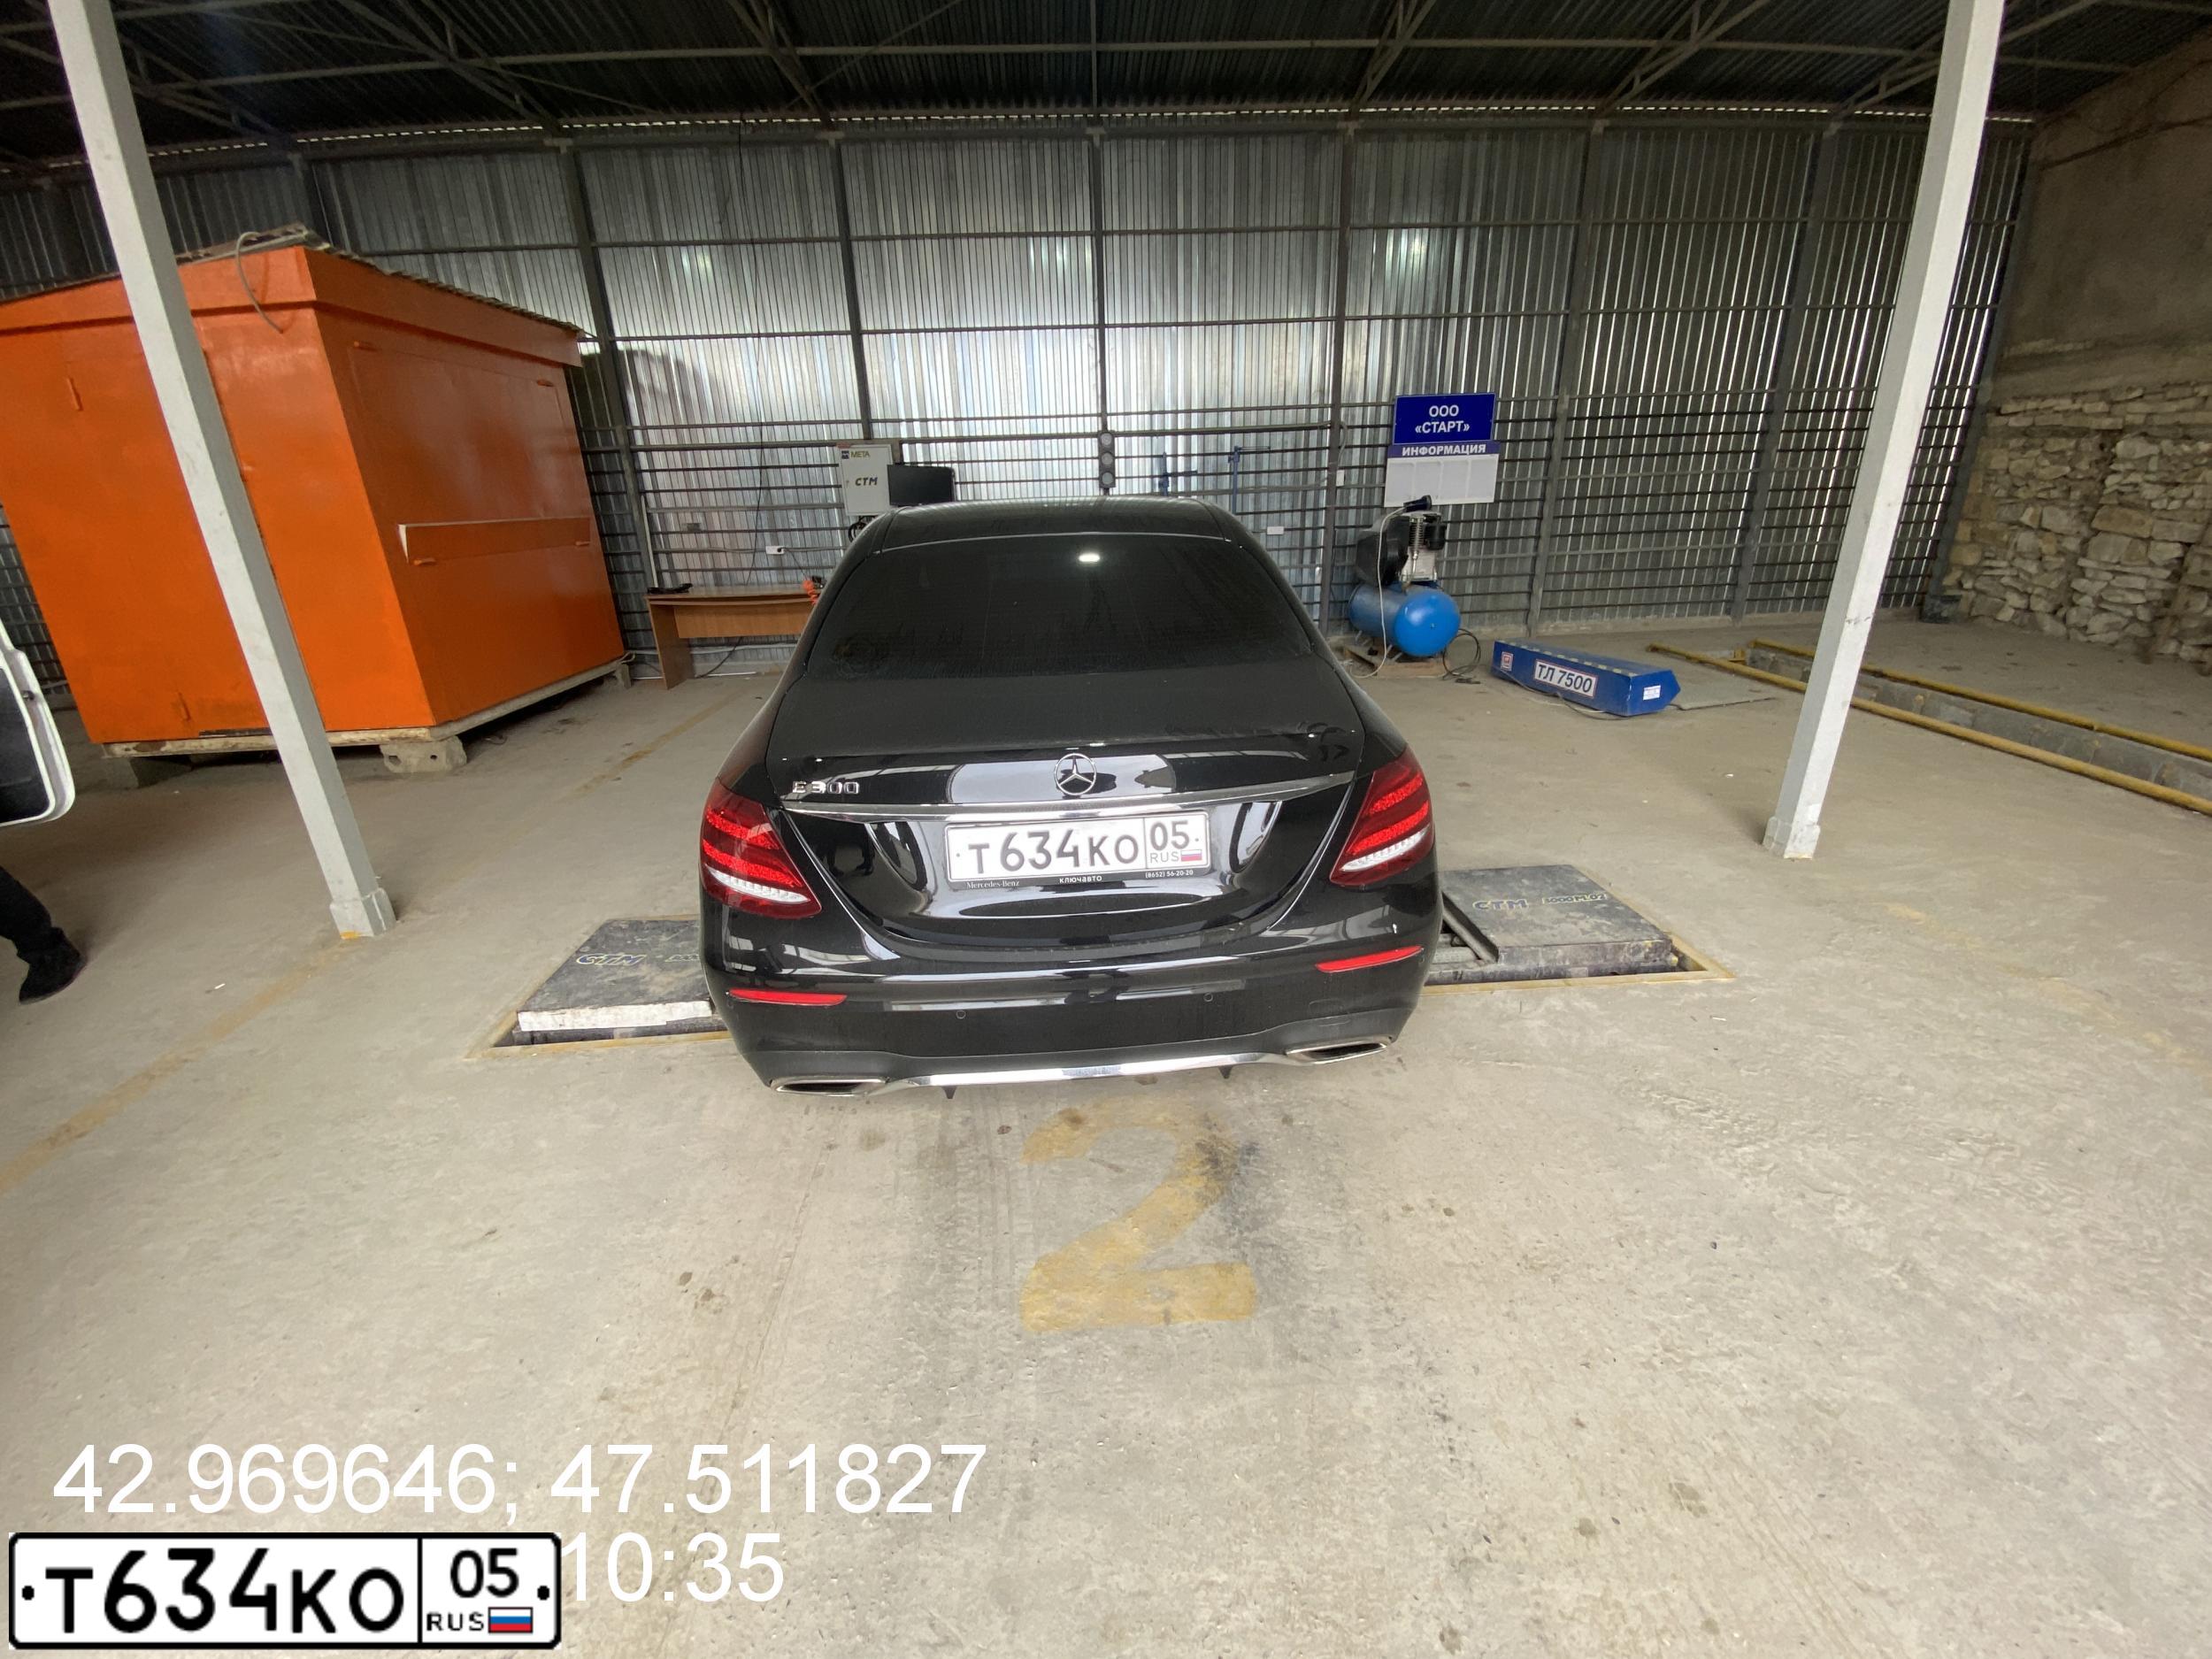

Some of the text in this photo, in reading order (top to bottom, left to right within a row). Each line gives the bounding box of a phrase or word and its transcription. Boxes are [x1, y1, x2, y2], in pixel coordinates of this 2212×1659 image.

[1429, 404, 1459, 417] ООО
[1415, 420, 1470, 434] «СТАРТ»
[1402, 444, 1486, 457] ИНФОРМАЦИЯ
[1537, 664, 1593, 693] ТЛ 7500
[968, 820, 1189, 874] Т634КО 05
[1149, 851, 1179, 864] RUS
[966, 879, 1020, 889] Mercedes-Benz
[1059, 875, 1102, 884] ключавто
[1020, 1099, 1258, 1332] 2
